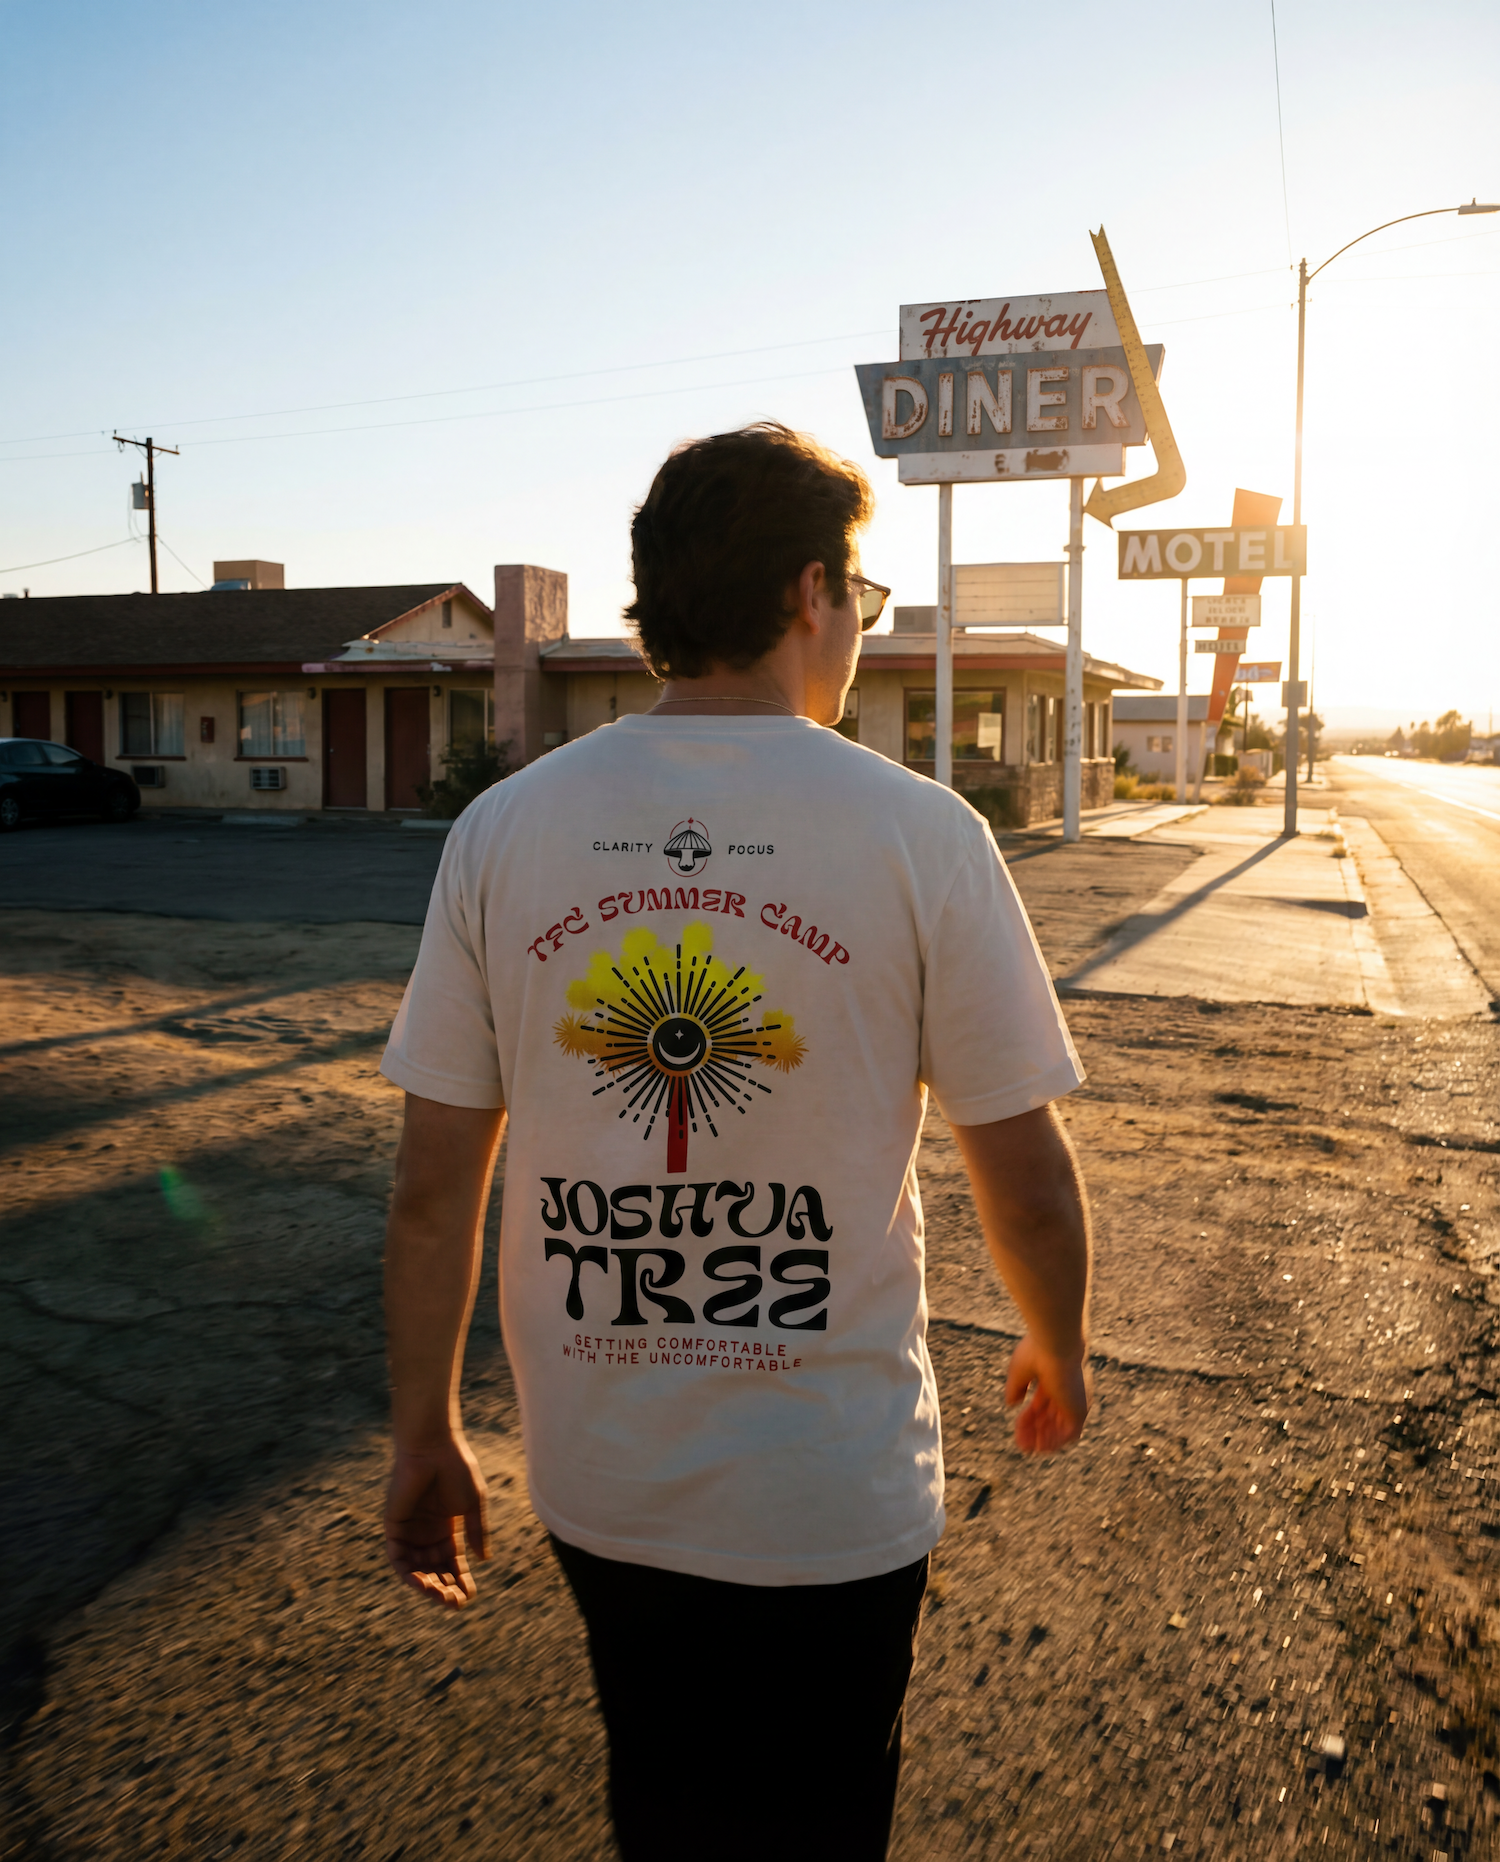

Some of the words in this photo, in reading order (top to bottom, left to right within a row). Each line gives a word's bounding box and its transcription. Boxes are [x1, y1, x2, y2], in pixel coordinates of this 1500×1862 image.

[919, 302, 1093, 356] Highway
[881, 364, 1131, 440] DINER
[1122, 530, 1293, 573] MOTEL
[592, 841, 653, 853] CLARITY
[597, 886, 746, 922] SUMMER
[760, 902, 850, 965] CAMP
[540, 1177, 834, 1242] JOSHUA
[544, 1237, 831, 1331] TREE
[562, 1344, 597, 1364] WITH
[605, 1352, 640, 1365] THE
[649, 1353, 803, 1372] UNCOMFORTABLE
[574, 1334, 648, 1351] GETTING
[656, 1337, 787, 1358] COMFORTABLE
